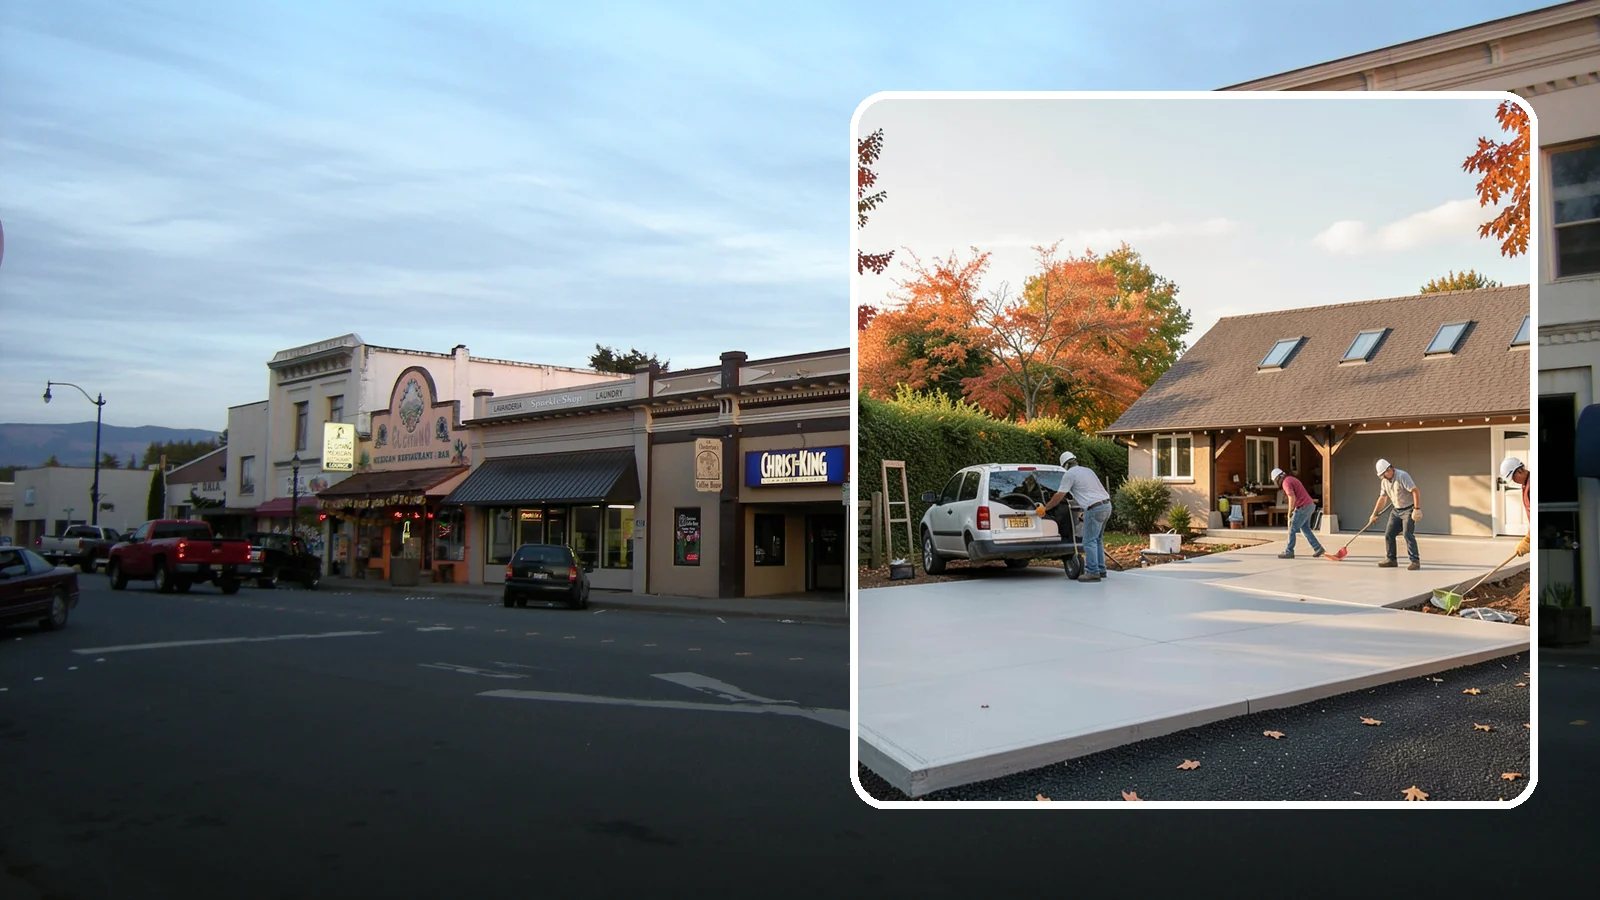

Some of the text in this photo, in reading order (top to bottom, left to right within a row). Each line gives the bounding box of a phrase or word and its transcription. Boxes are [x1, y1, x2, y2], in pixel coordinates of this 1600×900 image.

[493, 389, 623, 413] LAVANDERIA Sparkle Shop LAUNDRY
[397, 451, 433, 462] RESTAURANT
[438, 450, 450, 459] BAR
[799, 450, 828, 476] KING
